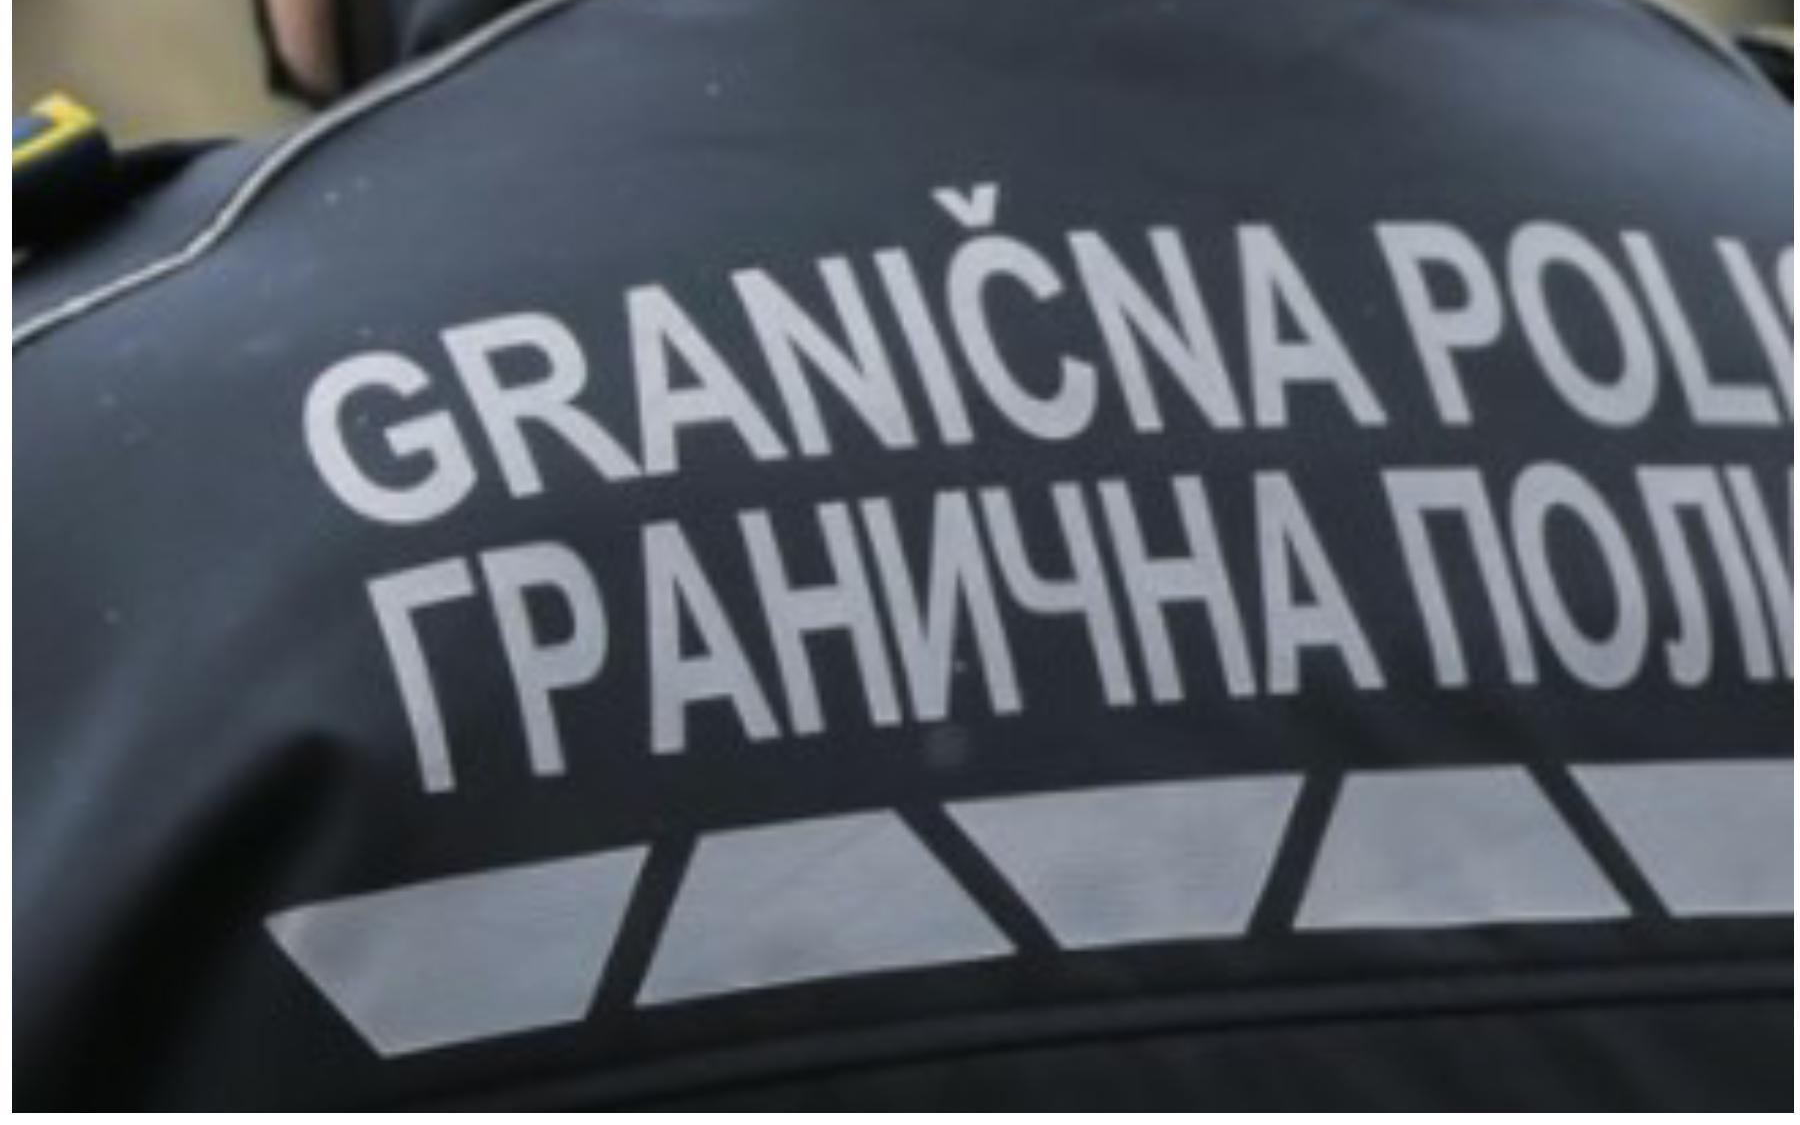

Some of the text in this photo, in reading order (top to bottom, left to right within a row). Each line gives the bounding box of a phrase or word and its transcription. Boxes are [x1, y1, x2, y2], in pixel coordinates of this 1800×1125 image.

[302, 182, 1793, 527] GRANIČNA POLI
[366, 471, 1384, 792] ГРАНИЧНА
